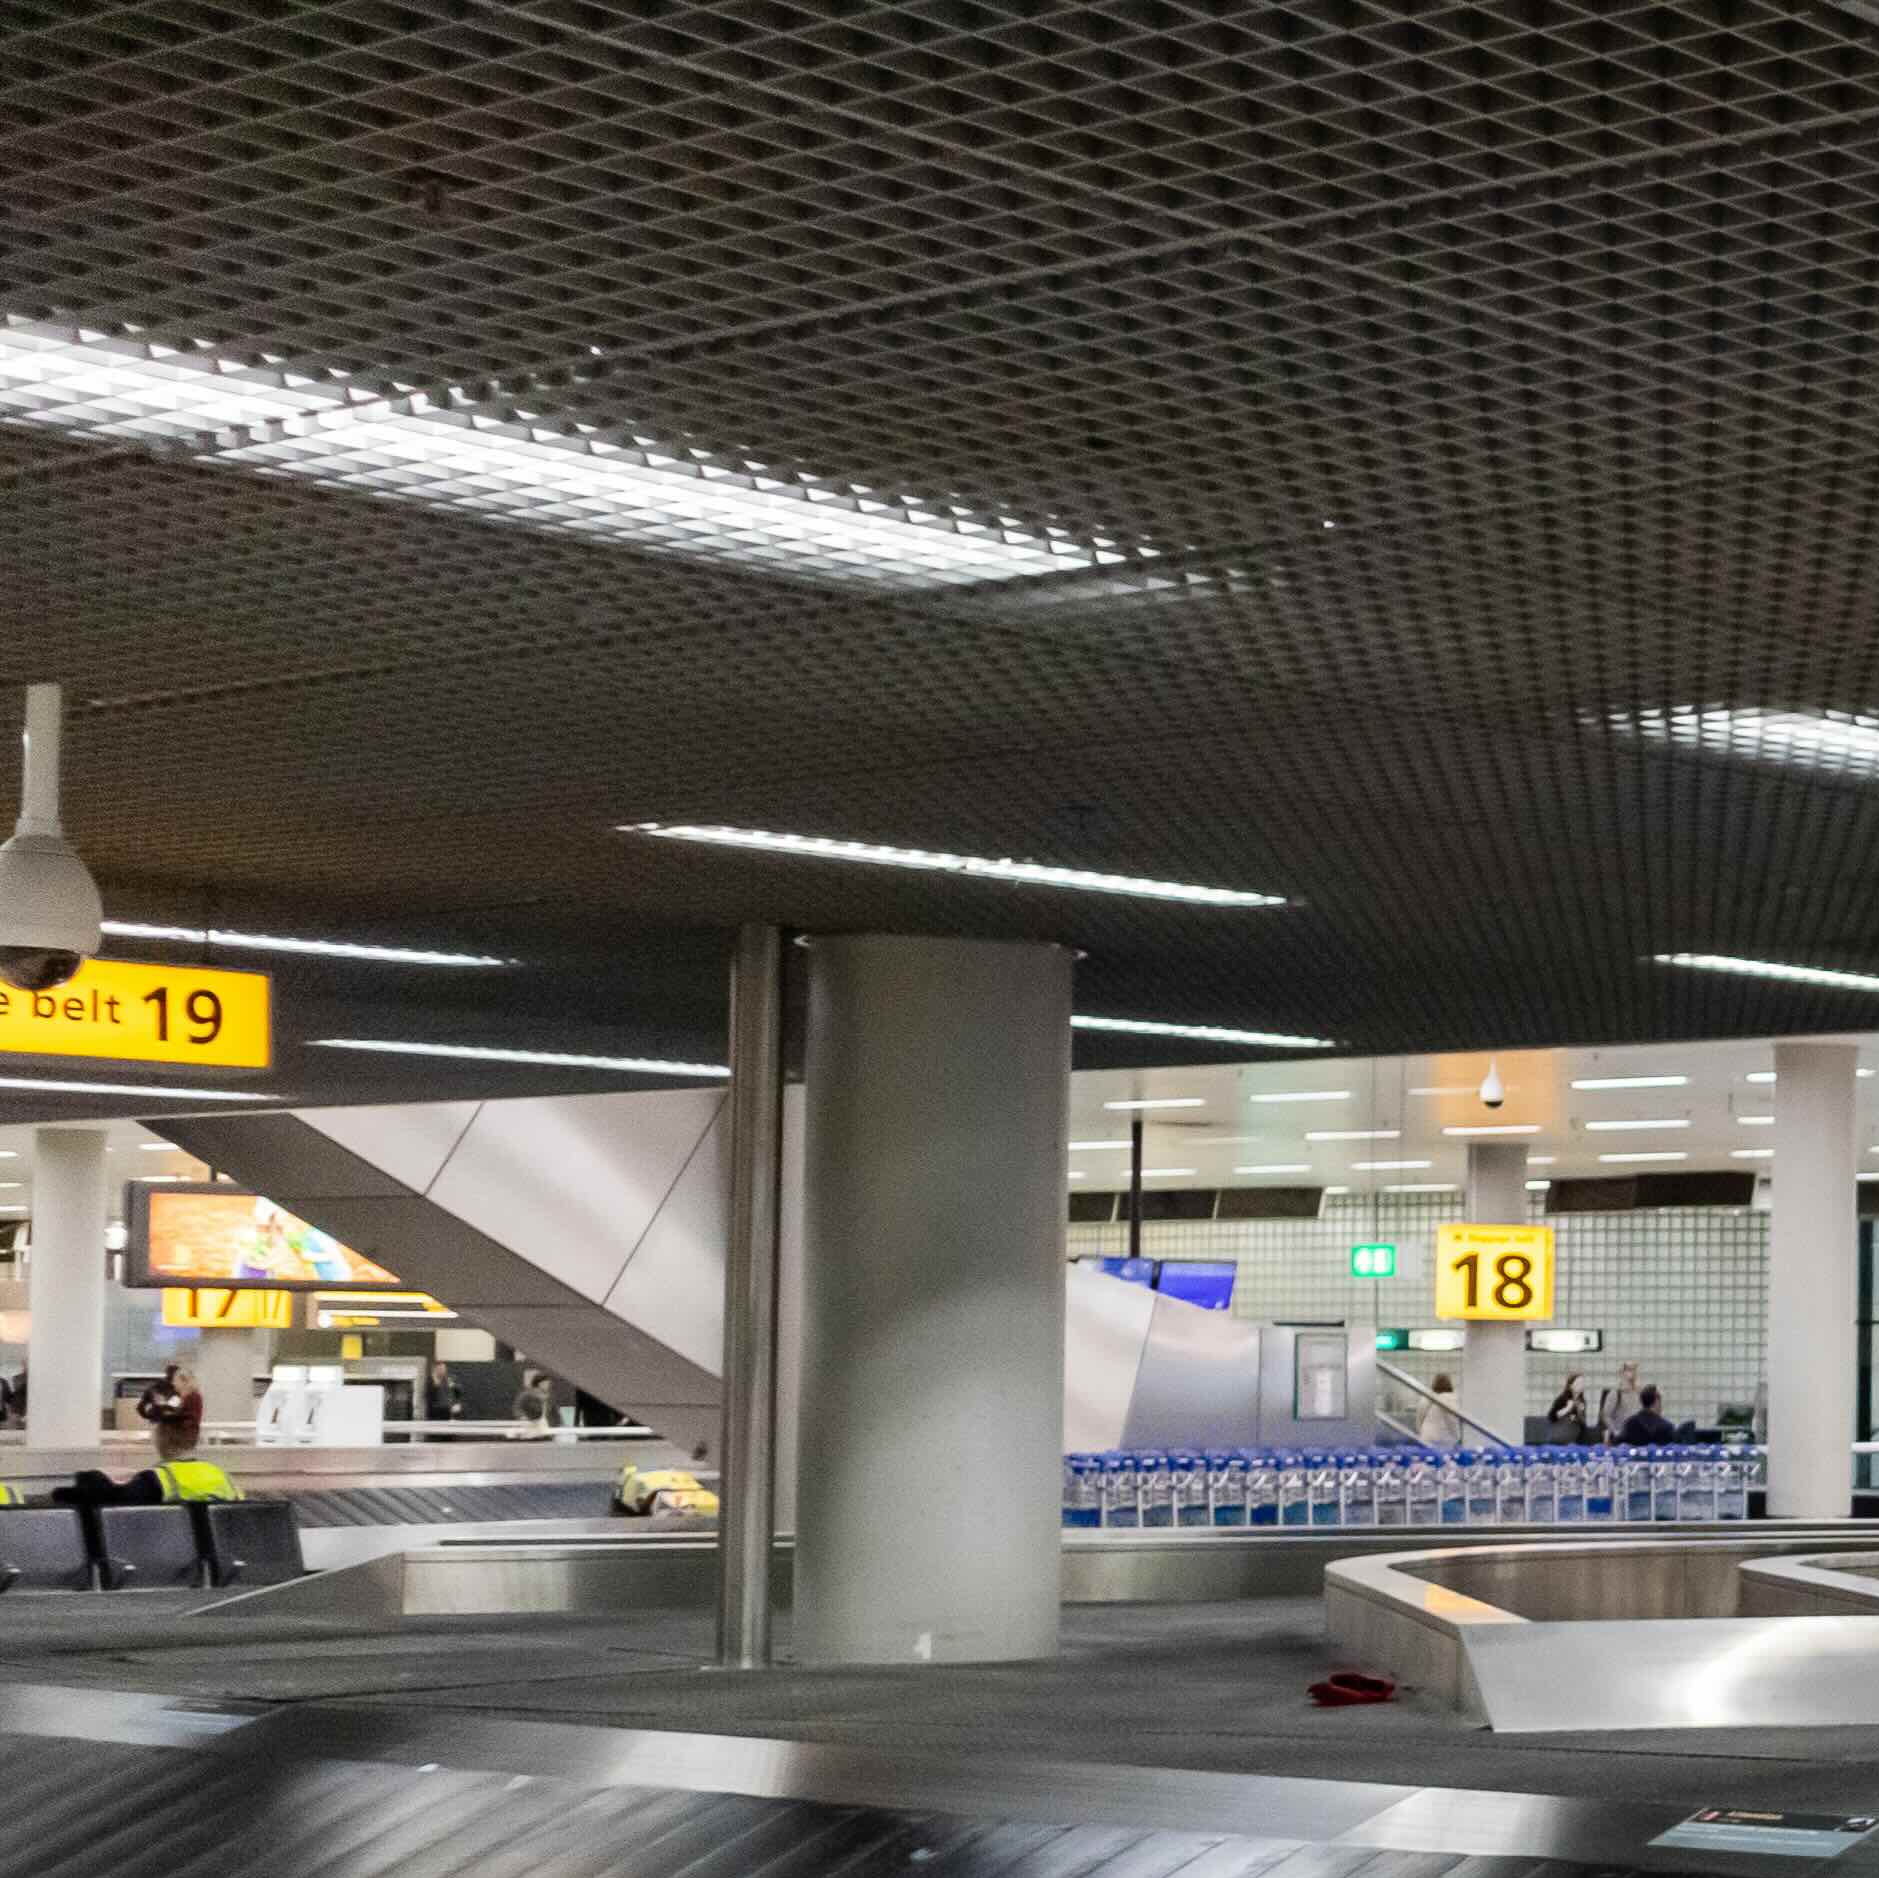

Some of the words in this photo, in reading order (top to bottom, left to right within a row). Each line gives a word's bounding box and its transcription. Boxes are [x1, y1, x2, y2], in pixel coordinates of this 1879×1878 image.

[31, 988, 121, 1025] belt
[142, 986, 224, 1045] 19
[1453, 1254, 1533, 1309] 18
